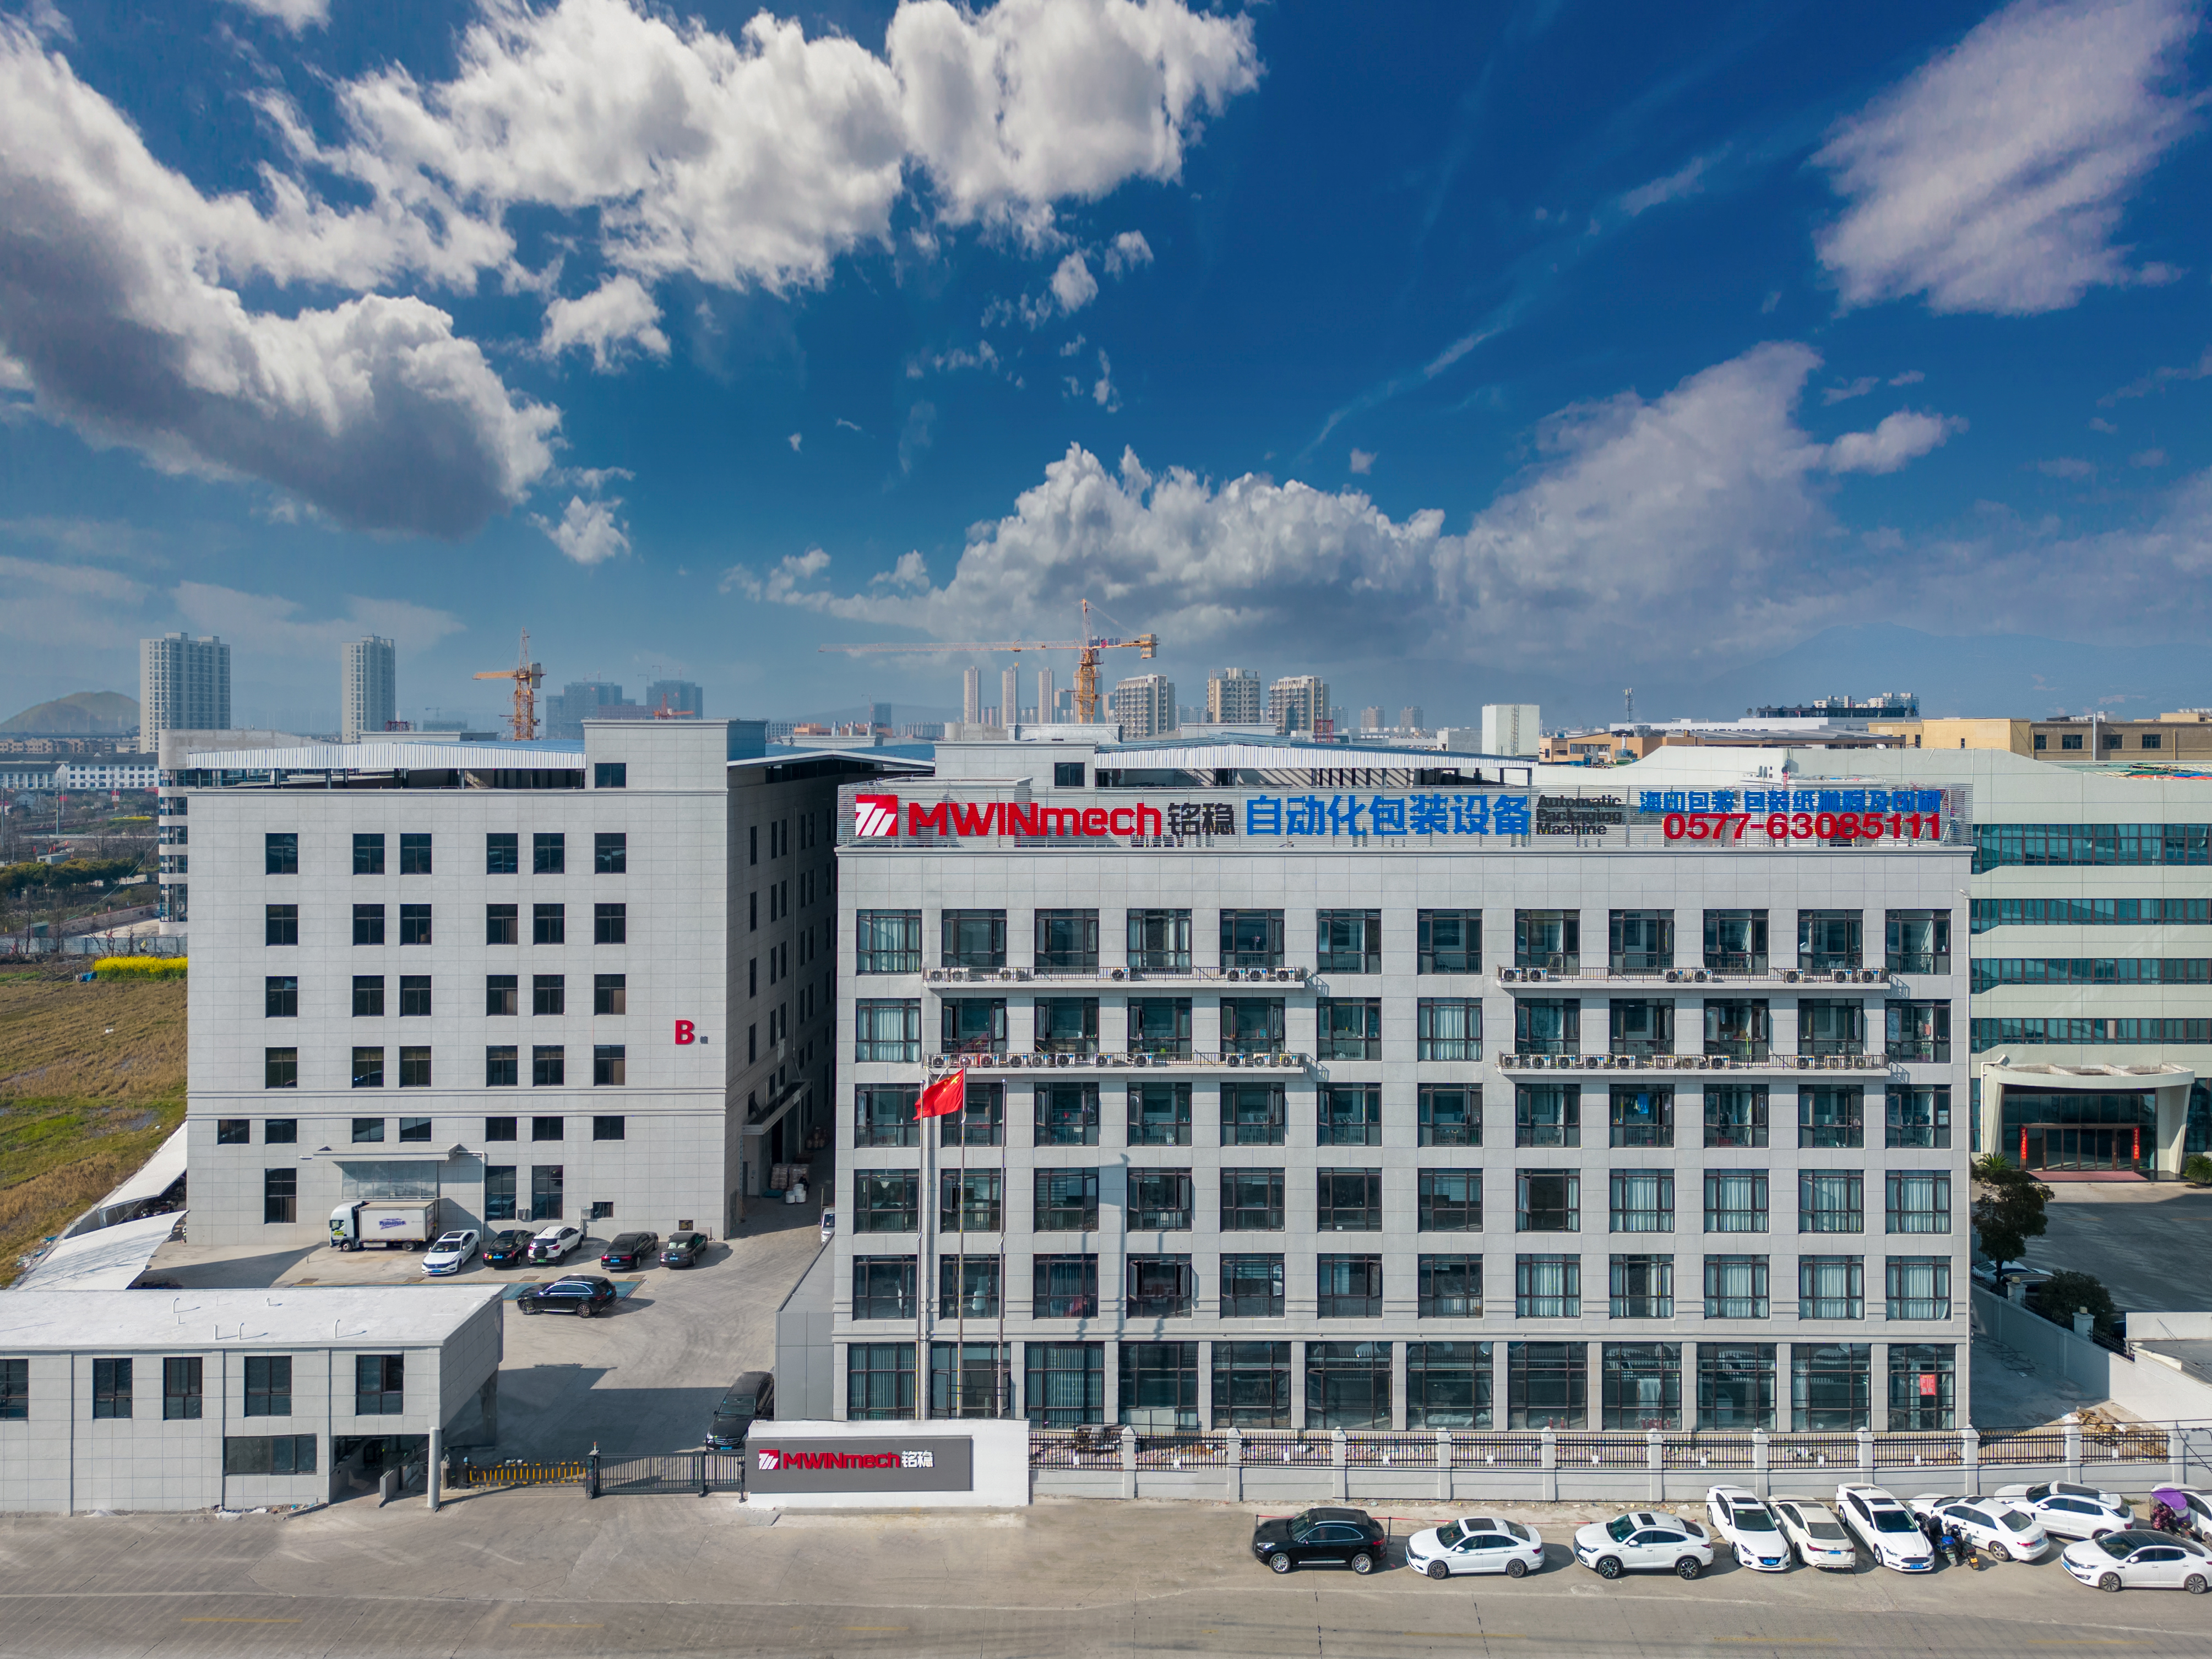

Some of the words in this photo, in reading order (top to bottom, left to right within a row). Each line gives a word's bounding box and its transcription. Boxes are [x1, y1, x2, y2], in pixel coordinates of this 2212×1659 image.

[1537, 795, 1622, 807] Automatic
[1744, 790, 1941, 813] 包装纸淋膜及印刷
[909, 802, 1162, 836] MWINmech
[1167, 802, 1236, 836] 铭稳
[1247, 794, 1531, 836] 自动化包装设备
[1536, 808, 1622, 824] Packaging
[1536, 822, 1607, 835] Machine
[1664, 813, 1940, 839] 0577-63085111
[783, 1451, 900, 1469] MWINmech
[901, 1451, 933, 1468] 铭稳
